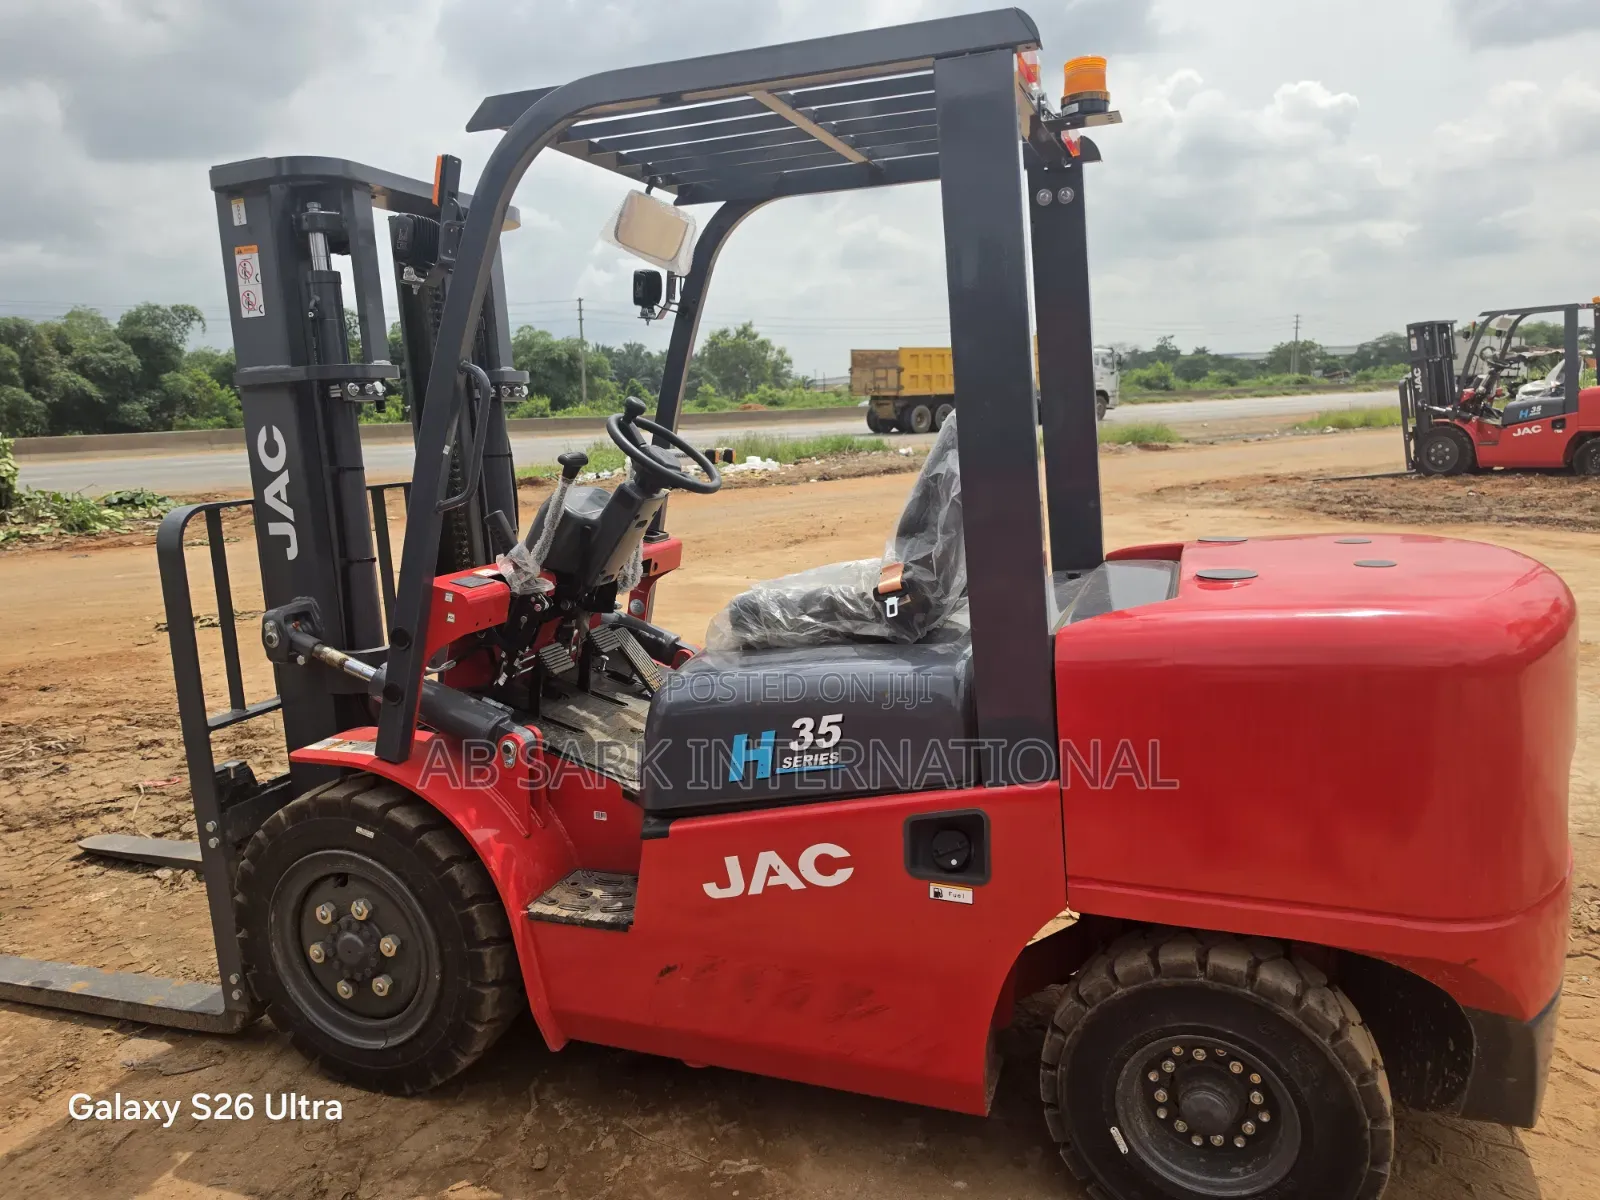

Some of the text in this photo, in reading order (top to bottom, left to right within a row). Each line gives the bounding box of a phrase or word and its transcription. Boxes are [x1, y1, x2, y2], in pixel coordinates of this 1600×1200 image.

[1413, 367, 1423, 393] JAC
[1512, 425, 1542, 437] JAC
[257, 425, 299, 561] JAC
[729, 713, 844, 782] H 35
[782, 751, 841, 769] SERIES
[702, 842, 855, 899] JAC
[948, 891, 966, 900] Fuel
